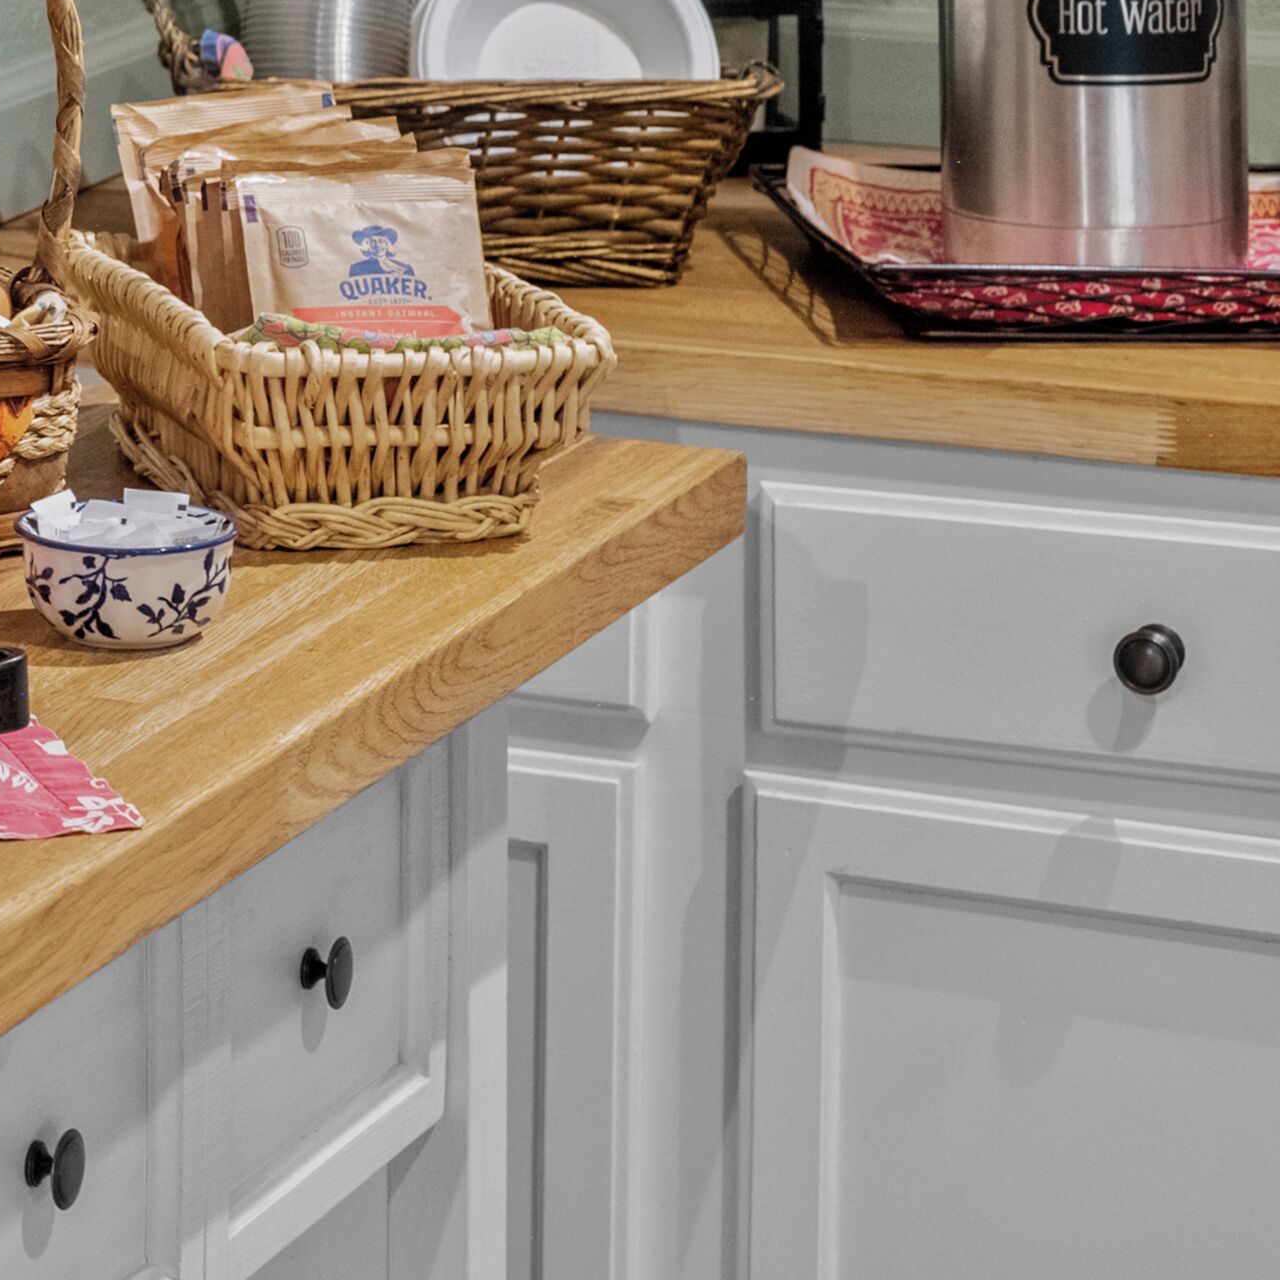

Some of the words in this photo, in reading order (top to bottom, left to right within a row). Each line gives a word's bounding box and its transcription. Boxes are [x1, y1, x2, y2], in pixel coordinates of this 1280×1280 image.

[281, 231, 301, 248] 100
[335, 310, 382, 318] INSTANT
[387, 309, 436, 318] OATMEAL
